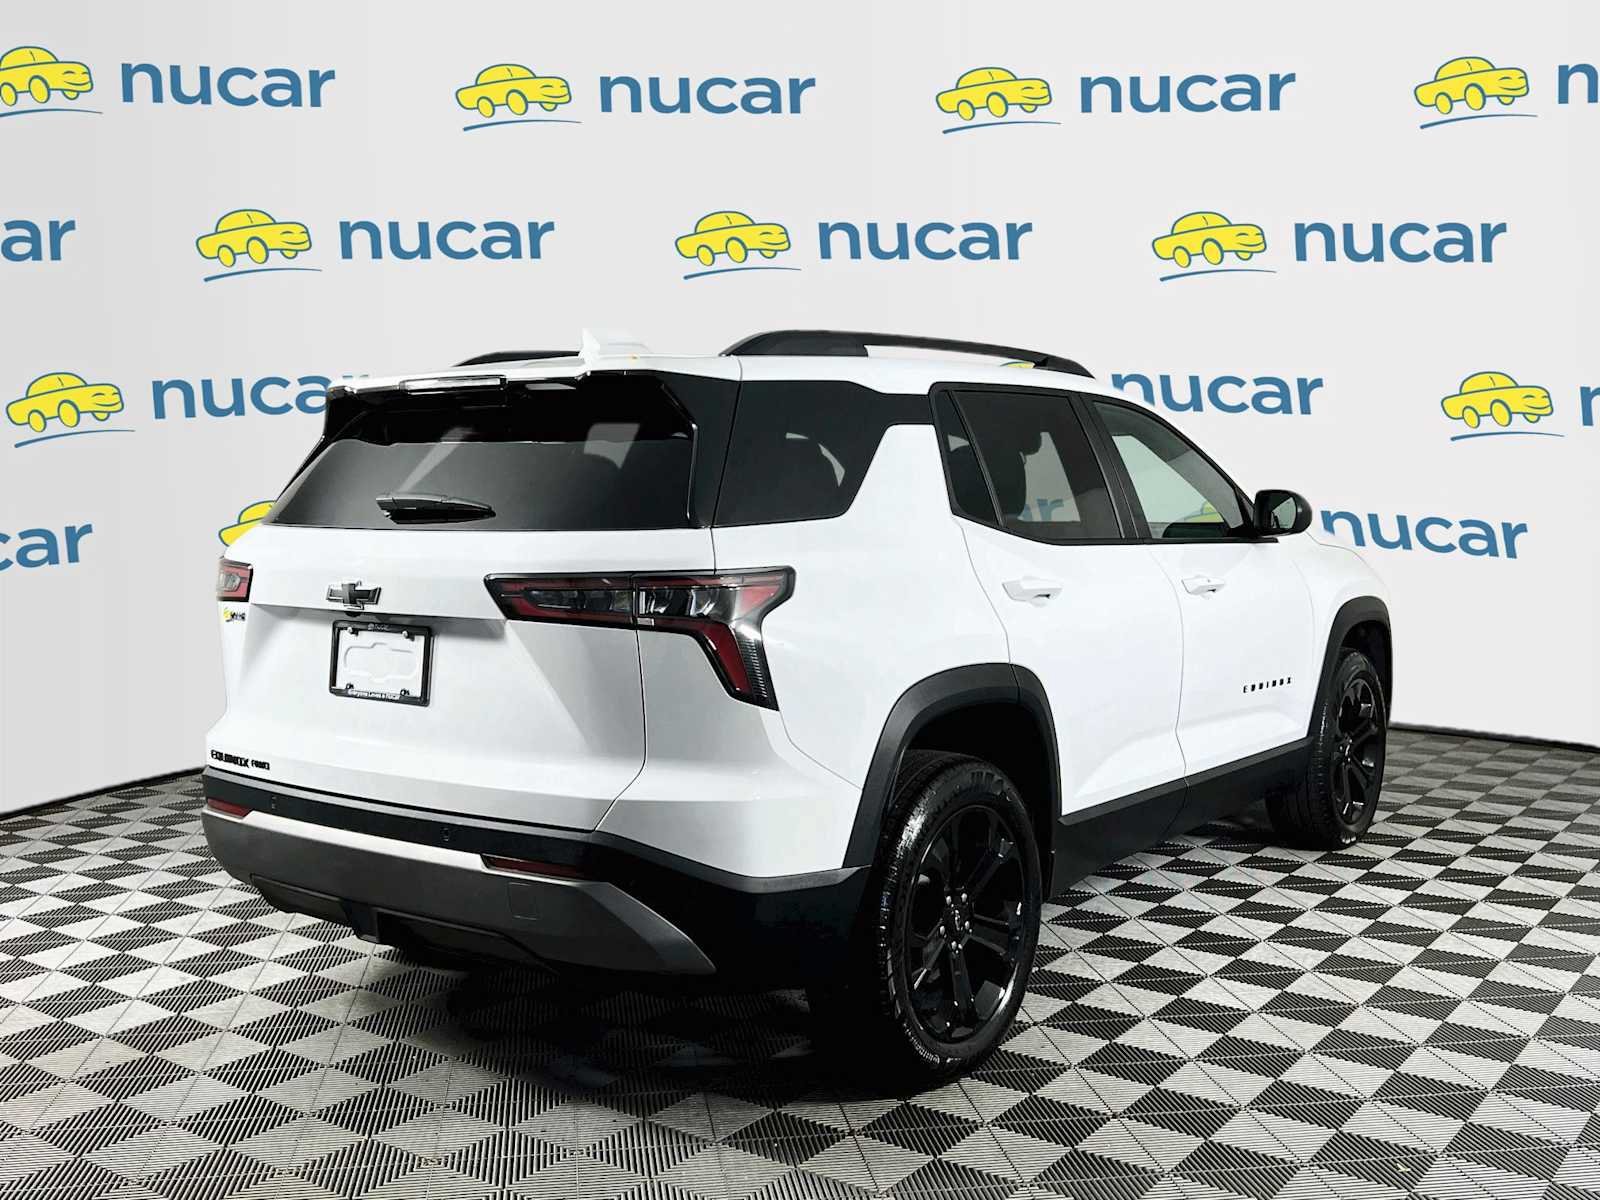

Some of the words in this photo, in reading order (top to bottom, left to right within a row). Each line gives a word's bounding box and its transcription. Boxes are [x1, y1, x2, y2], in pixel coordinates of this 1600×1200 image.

[121, 62, 336, 108] nucar
[599, 75, 817, 115] nucar
[1080, 73, 1297, 113] nucar
[339, 220, 555, 261] nucar
[818, 222, 1033, 261] nucar
[1294, 222, 1508, 263] nucar
[152, 374, 332, 420] nuca
[1111, 373, 1324, 415] nucar
[1320, 510, 1528, 560] nucar
